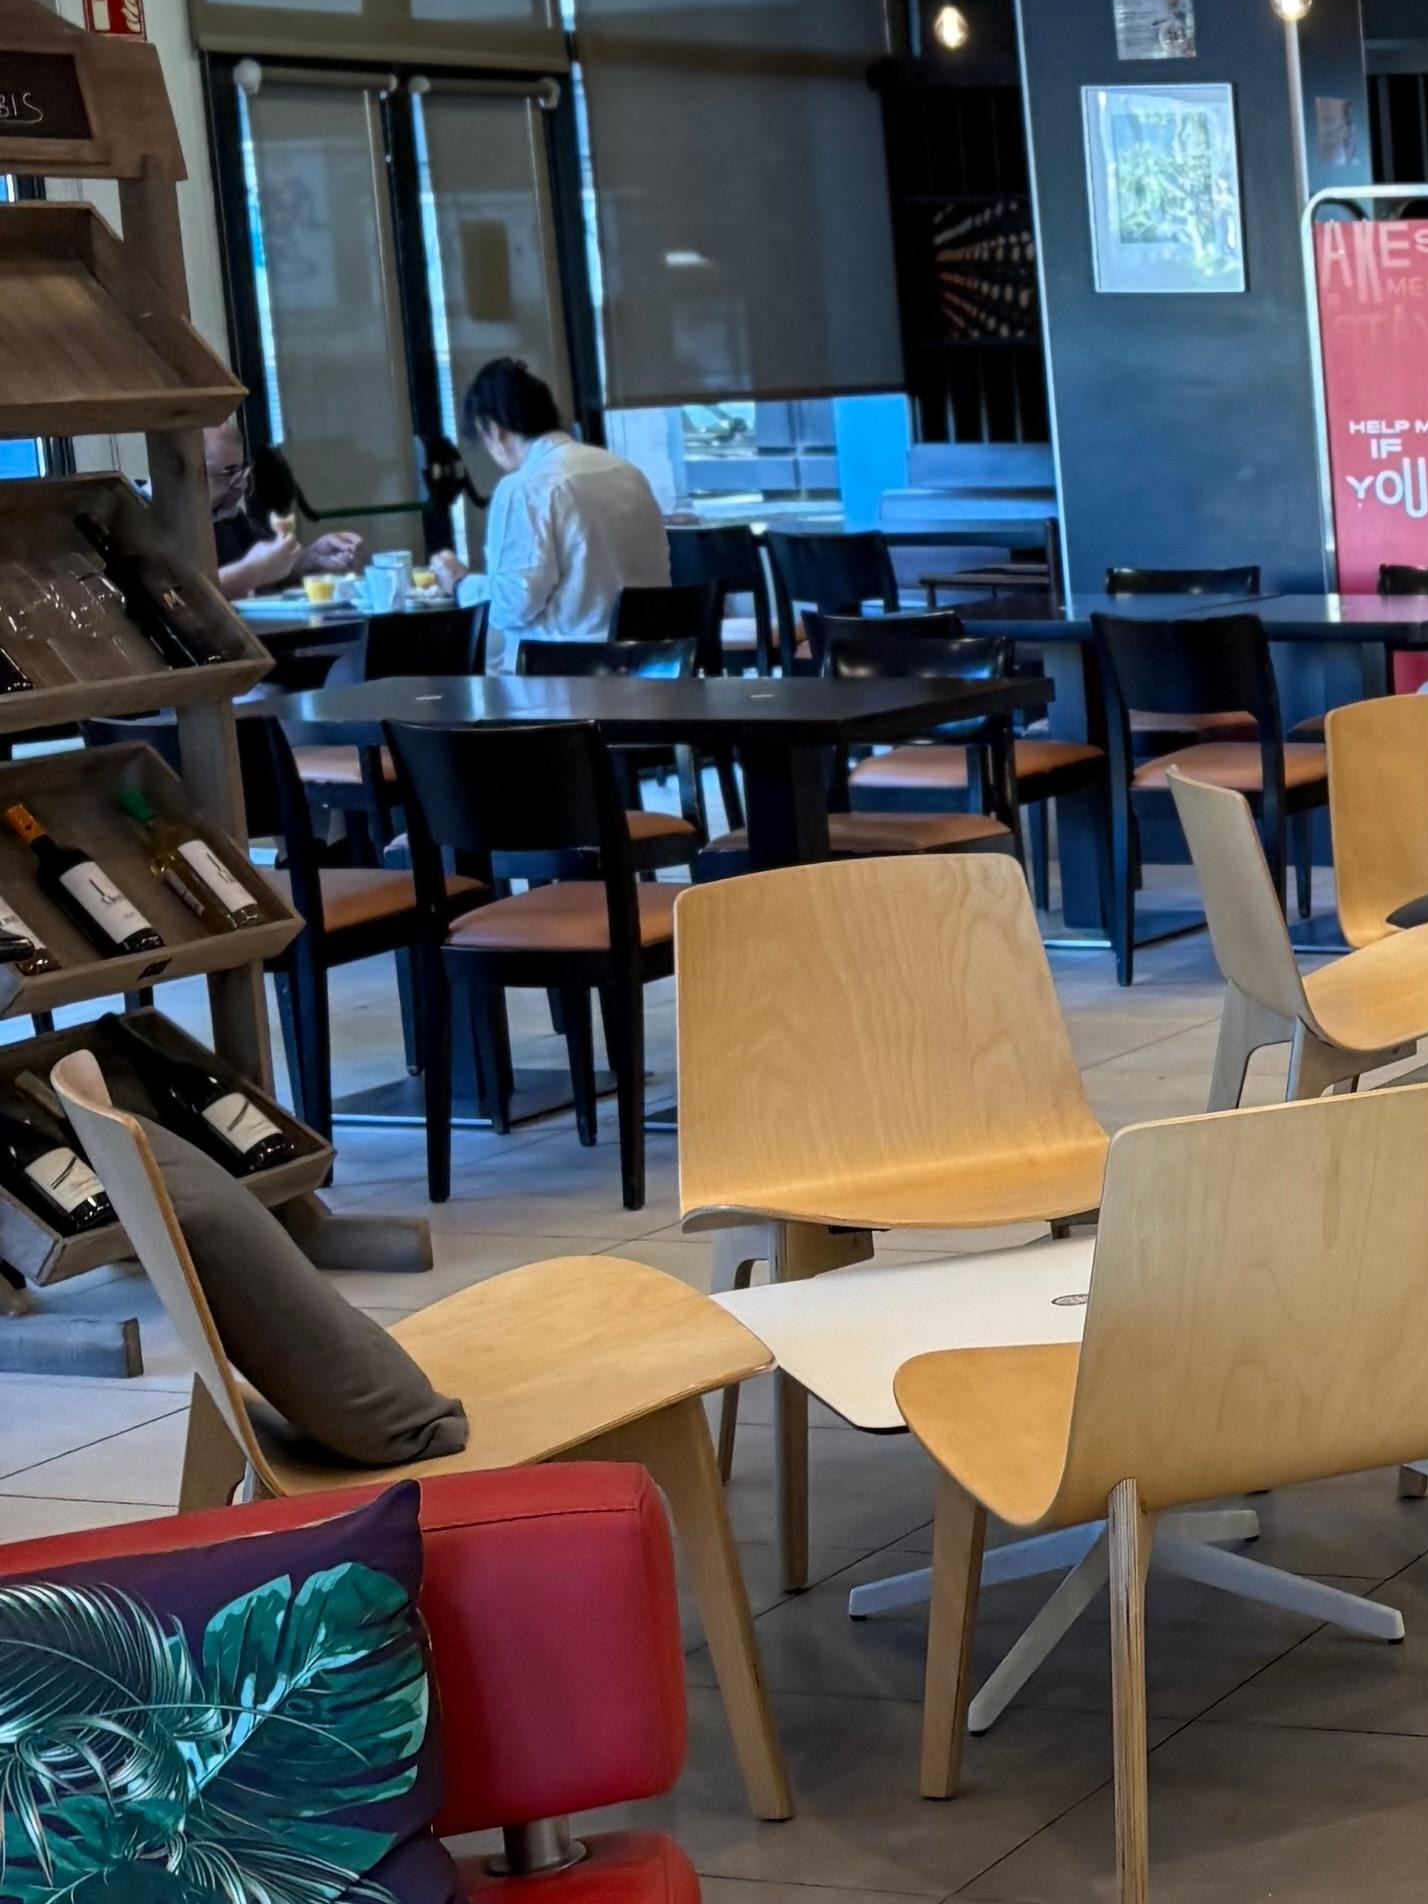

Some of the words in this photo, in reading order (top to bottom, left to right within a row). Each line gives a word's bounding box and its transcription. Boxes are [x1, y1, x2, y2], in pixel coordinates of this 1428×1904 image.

[1349, 420, 1410, 435] HELP
[1370, 438, 1402, 459] IF
[1345, 456, 1428, 518] YOU
